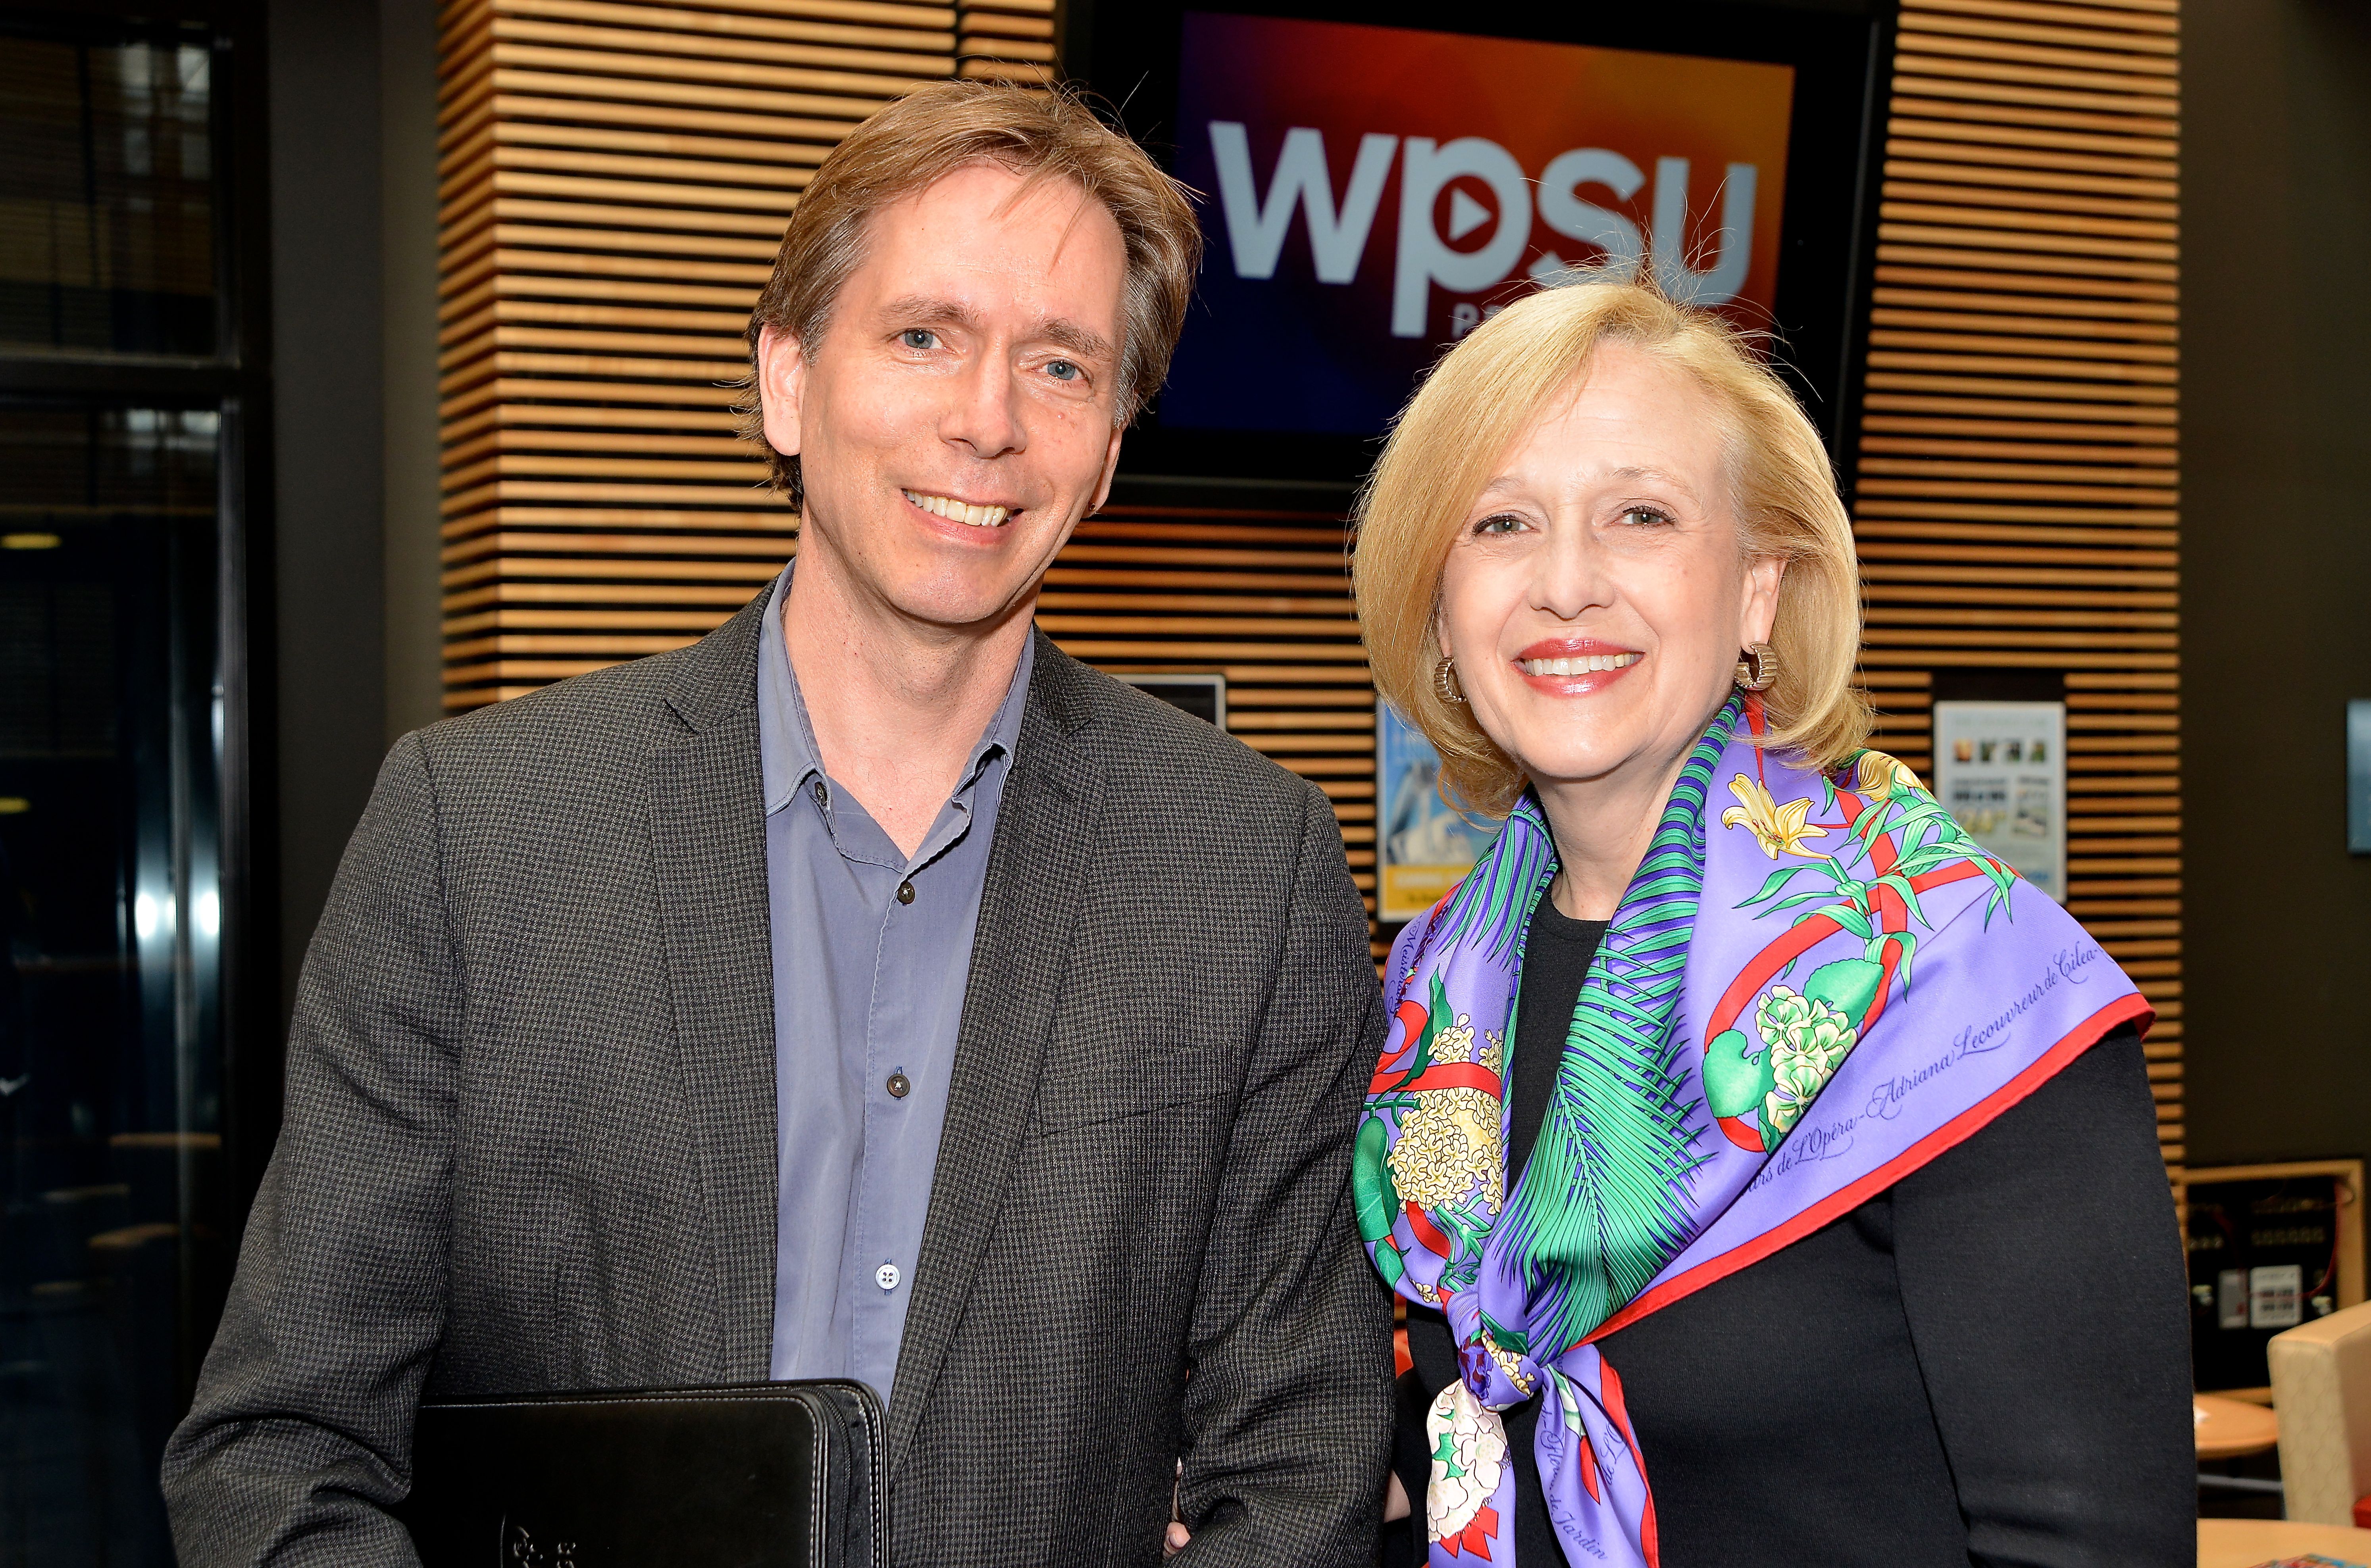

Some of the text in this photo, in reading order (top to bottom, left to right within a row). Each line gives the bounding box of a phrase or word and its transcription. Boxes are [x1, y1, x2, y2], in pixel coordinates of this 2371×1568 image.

[1208, 120, 1758, 339] wpsu
[1777, 1152, 1792, 1176] de
[1866, 1050, 1954, 1120] Adriana
[1953, 983, 2044, 1061] Lecouvreur
[2045, 966, 2058, 990] de
[1550, 1494, 1562, 1510] de
[1552, 1511, 1608, 1560] Jardin
